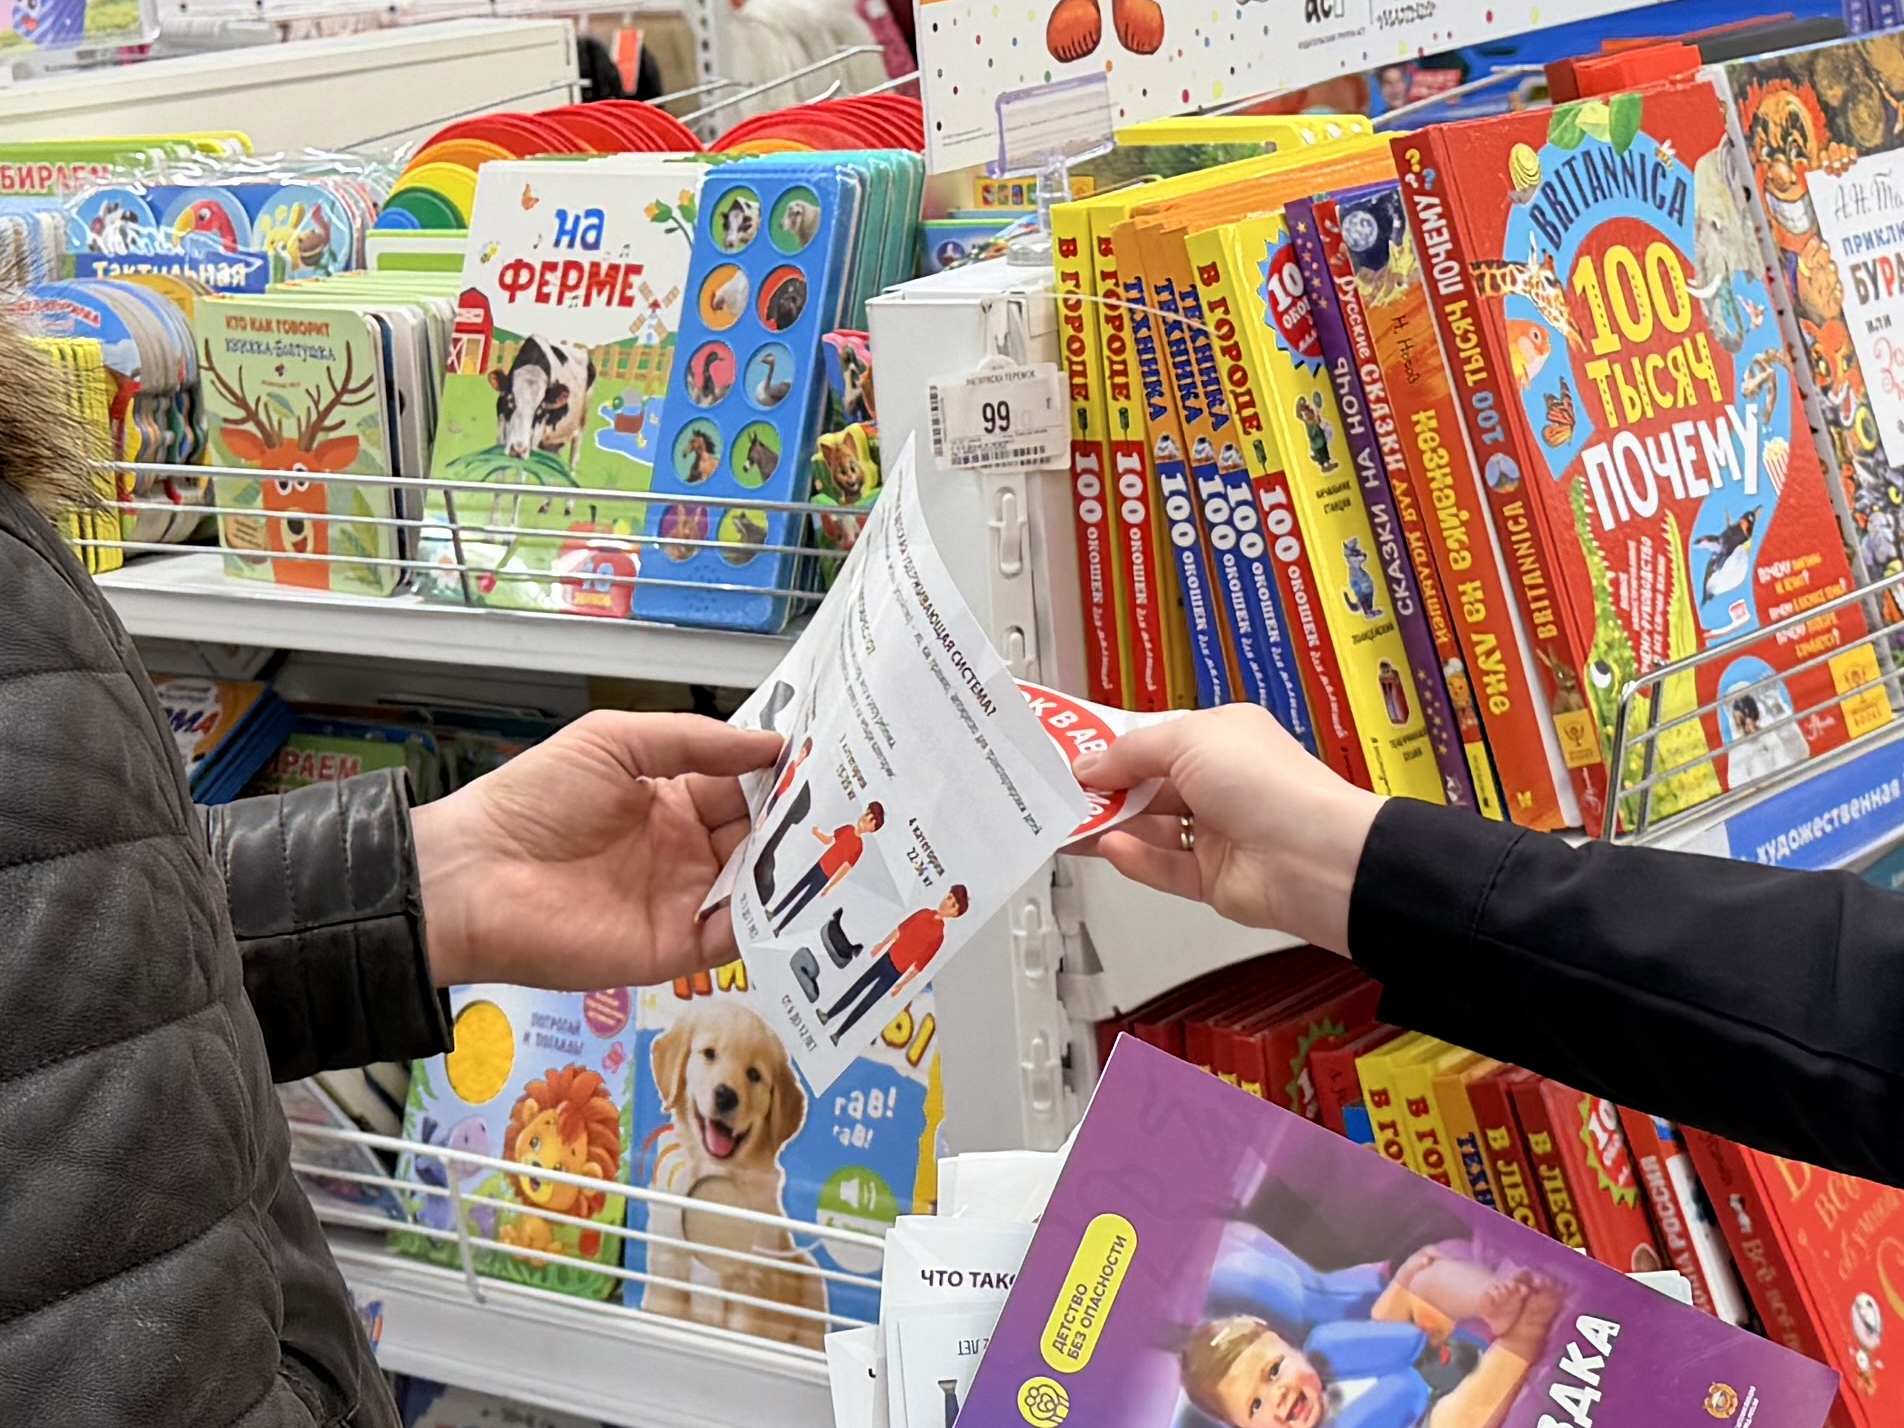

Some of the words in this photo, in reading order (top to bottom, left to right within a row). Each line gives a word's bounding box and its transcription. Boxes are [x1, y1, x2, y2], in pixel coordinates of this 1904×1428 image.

[1529, 144, 1688, 252] BRITANNICA
[498, 258, 645, 309] ФЕРМЕ
[1057, 236, 1079, 260] В
[1196, 261, 1222, 288] В
[1413, 194, 1465, 296] ПОЧЕМУ
[1060, 270, 1091, 402] ГОРОДЕ
[1100, 269, 1132, 402] ГОРОДЕ
[1572, 241, 1693, 357] 100
[1004, 369, 1037, 383] ТЕРЕМОК
[1122, 276, 1169, 422] ТЕХНИКА
[1153, 277, 1205, 426] ТЕХНИКА
[1208, 295, 1264, 437] ГОРОДЕ
[1444, 299, 1488, 388] ТЫСЯЧ
[1586, 332, 1724, 429] ТЫСЯЧ
[981, 399, 1011, 435] 99
[1333, 355, 1366, 436] НОЧЬ
[1359, 360, 1408, 473] СКАЗКИ
[1471, 390, 1505, 446] 100
[1075, 451, 1102, 524] 100
[1116, 451, 1146, 525] 100
[1356, 446, 1381, 488] НА
[1581, 403, 1759, 532] ПОЧЕМУ
[1160, 472, 1197, 549] 100
[1198, 474, 1238, 551] 100
[1226, 481, 1265, 559] 100
[1258, 484, 1302, 563] 100
[1372, 503, 1415, 616] СКАЗКИ
[1502, 500, 1559, 640] BRITANNICA
[950, 649, 998, 719] СИСТЕМА?
[1370, 1088, 1391, 1110] В
[1405, 1095, 1431, 1118] В
[1485, 1125, 1510, 1152] В
[1528, 1131, 1553, 1156] В
[920, 1269, 964, 1289] ЧТО
[1066, 1331, 1088, 1361] БЕЗ
[1081, 1234, 1129, 1330] ОПАСНОСТИ
[1051, 1282, 1089, 1355] ДЕТСТВО
